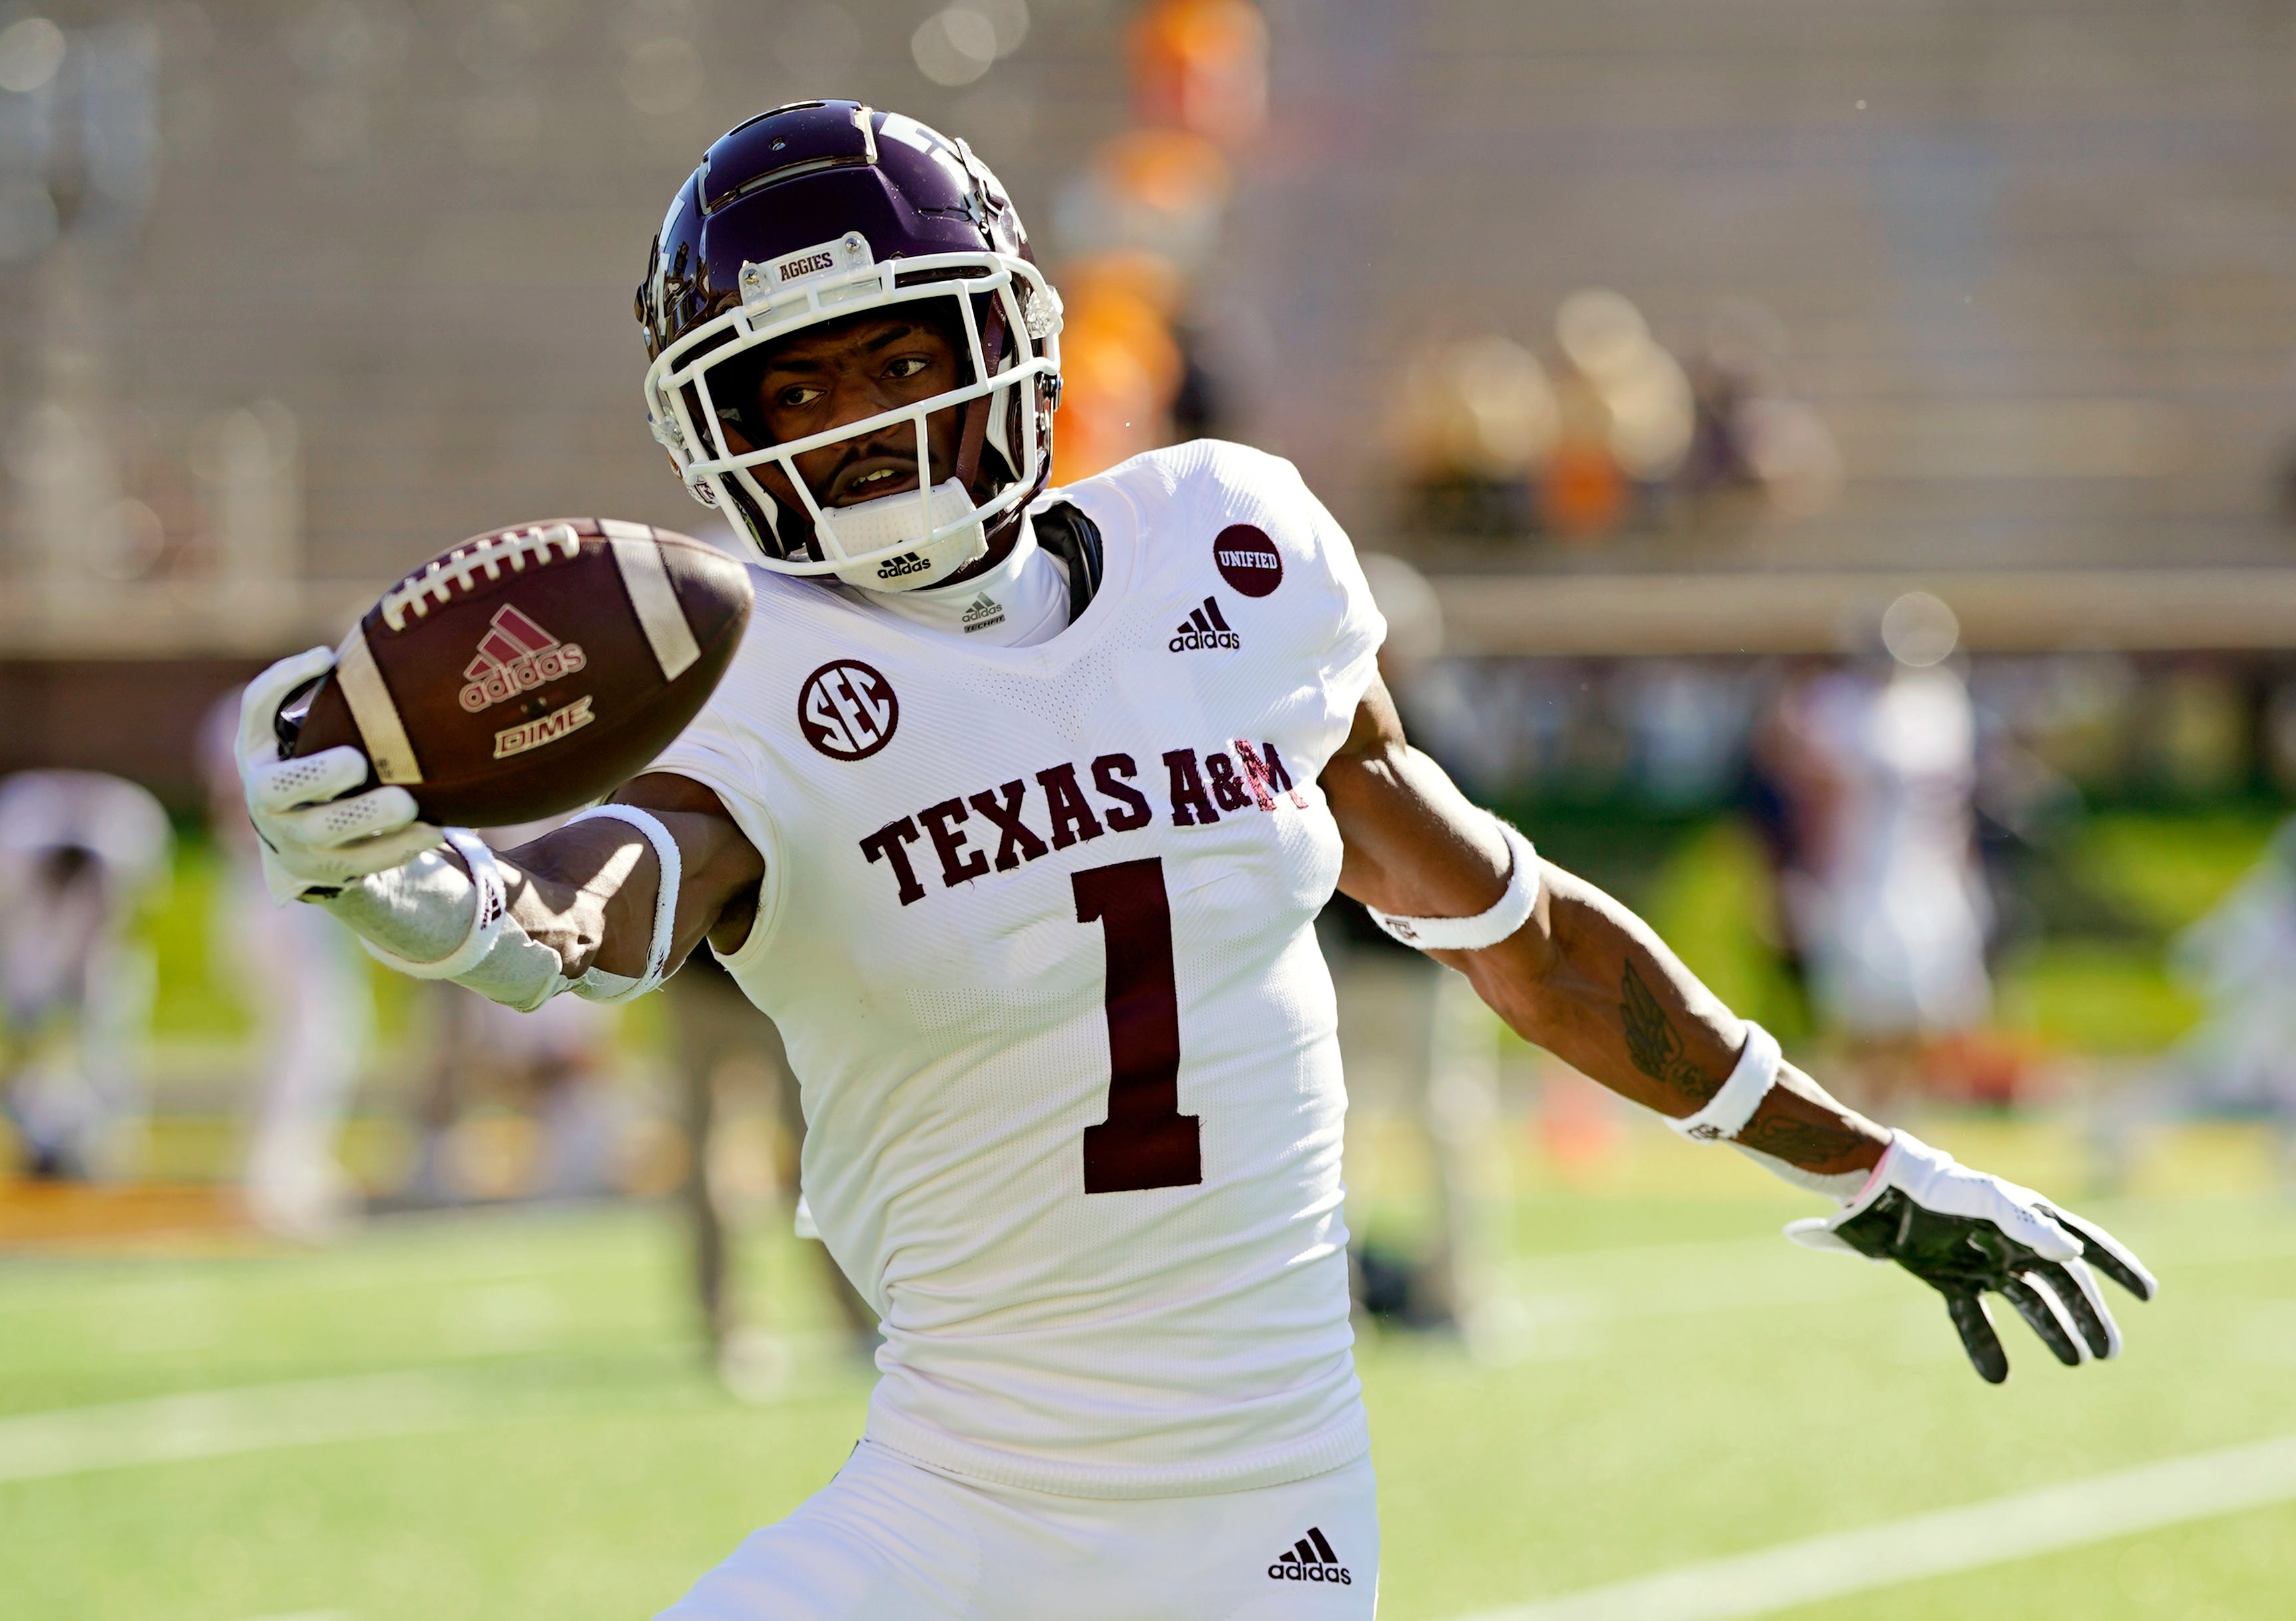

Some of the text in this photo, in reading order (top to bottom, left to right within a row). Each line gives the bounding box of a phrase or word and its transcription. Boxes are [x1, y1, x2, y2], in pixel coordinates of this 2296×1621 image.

[779, 252, 834, 282] AGGIES
[877, 558, 932, 579] adidas
[1218, 551, 1278, 570] UNIFIED
[962, 603, 1003, 622] adidas
[965, 614, 1005, 633] TECHFIT
[1168, 630, 1241, 653] adidas
[459, 642, 587, 713] adidas
[806, 666, 890, 753] SEC
[493, 694, 596, 760] DIME
[859, 739, 1308, 907] TEXAS A&M
[1070, 856, 1203, 1194] 1
[1268, 1560, 1352, 1586] adidas
